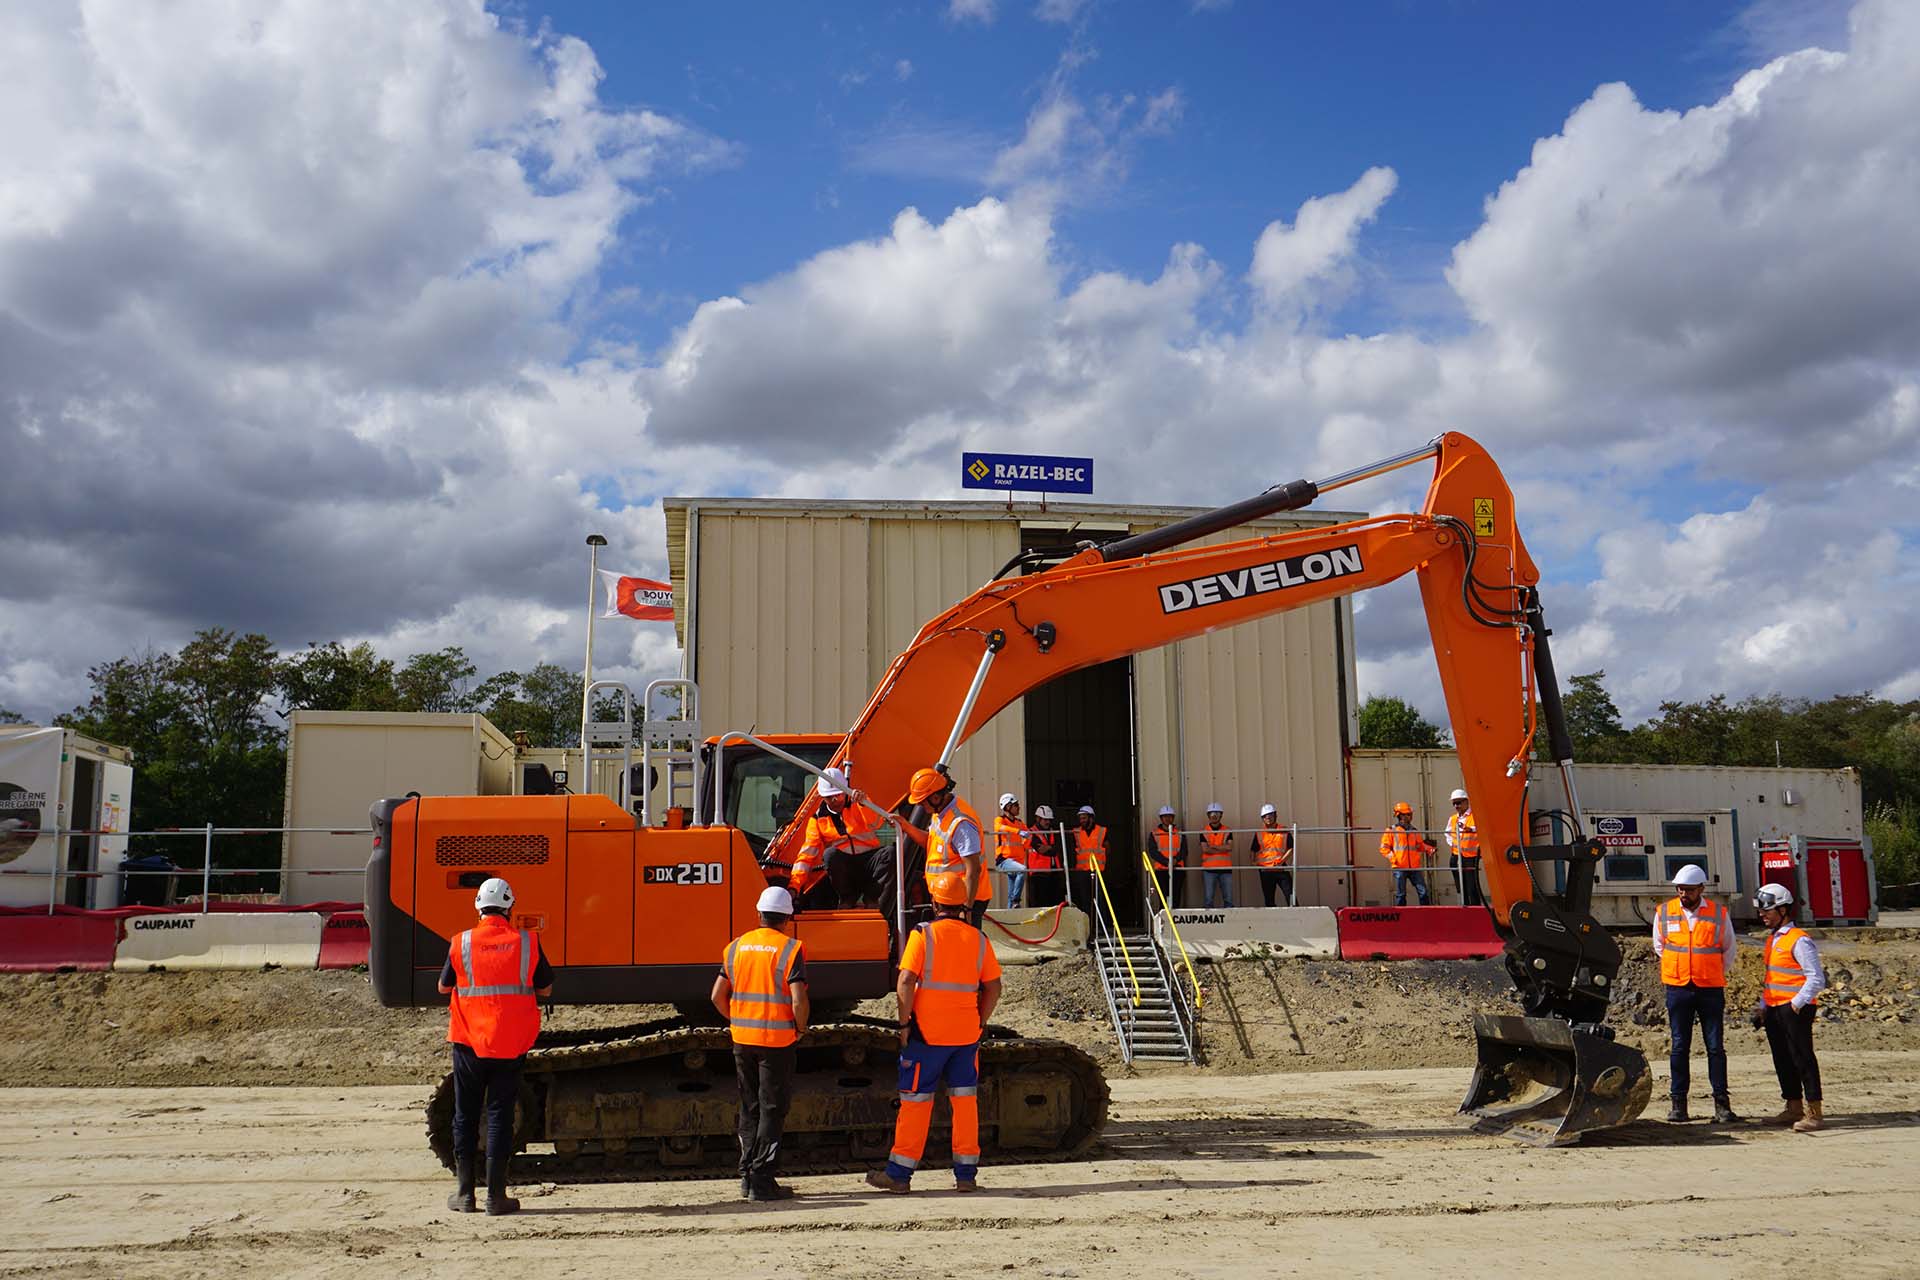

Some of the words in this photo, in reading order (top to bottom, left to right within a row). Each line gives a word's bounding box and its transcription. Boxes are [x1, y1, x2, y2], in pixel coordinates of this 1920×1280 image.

[994, 464, 1085, 482] RAZEL-BEC
[1160, 546, 1363, 613] DEVELON
[10, 792, 46, 800] STERNE
[1606, 837, 1642, 846] LOXAM
[677, 863, 723, 885] 230
[1172, 914, 1225, 924] CAUPAMAT
[1349, 912, 1401, 922] CAUPAMAT
[134, 919, 195, 930] CAUPAMAT
